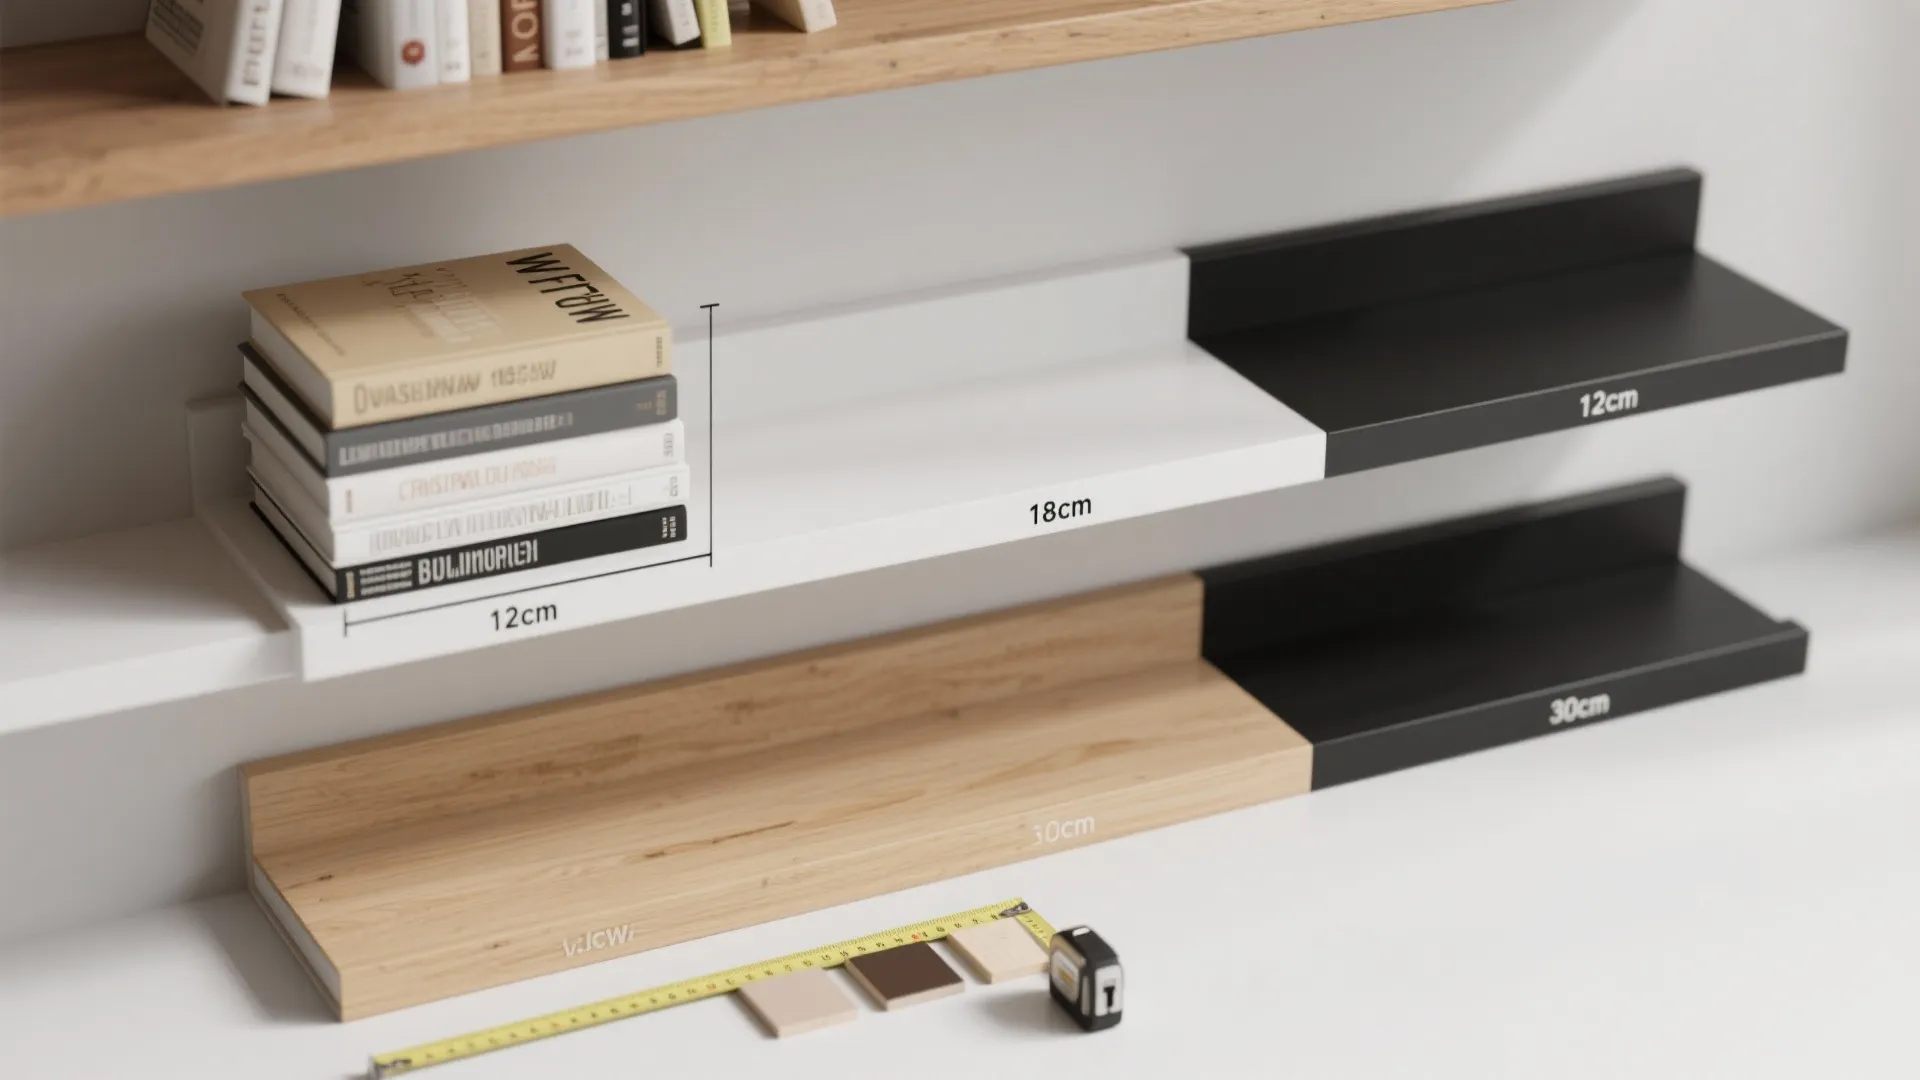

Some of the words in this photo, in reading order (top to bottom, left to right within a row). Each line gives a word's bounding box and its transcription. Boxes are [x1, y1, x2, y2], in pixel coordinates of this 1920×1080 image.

[1579, 388, 1639, 418] 12cm
[1029, 497, 1092, 525] 18cm
[490, 603, 557, 632] 12cm
[1548, 692, 1611, 726] 30cm
